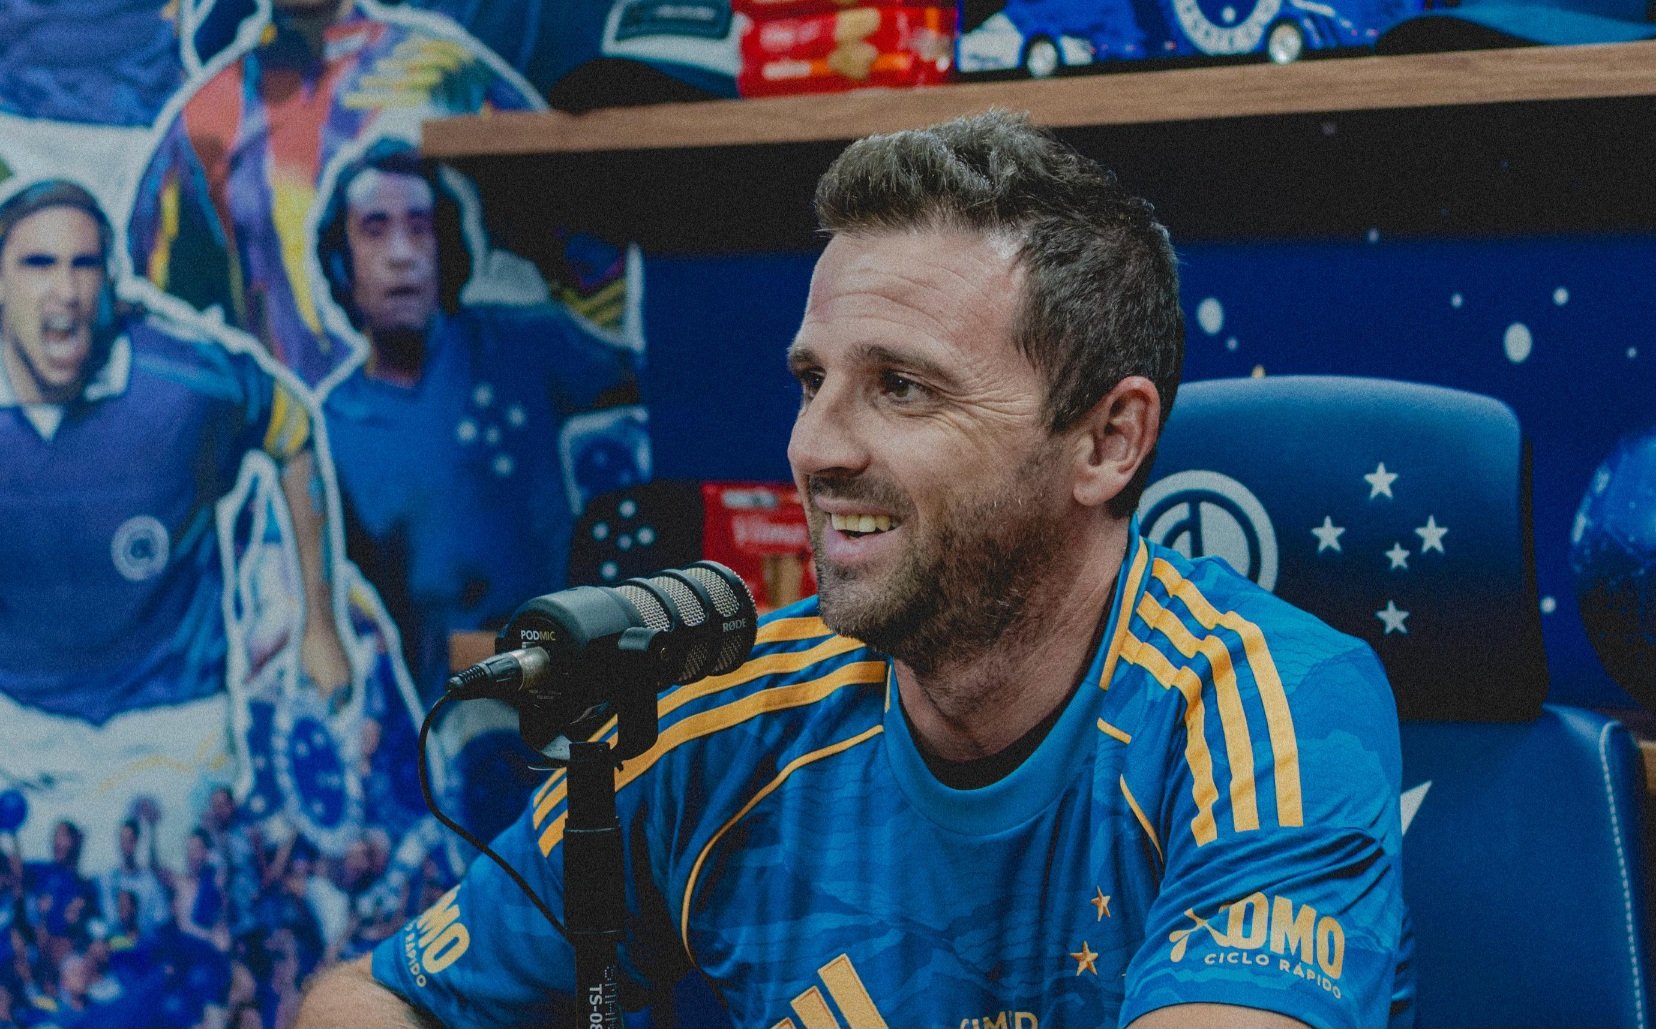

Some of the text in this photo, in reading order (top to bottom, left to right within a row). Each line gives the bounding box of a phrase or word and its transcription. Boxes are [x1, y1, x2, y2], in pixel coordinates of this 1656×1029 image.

[520, 630, 556, 641] PODMIC
[722, 618, 747, 633] RØDE
[416, 884, 471, 974] MO
[1204, 951, 1342, 1000] CICLO RÁPIDO
